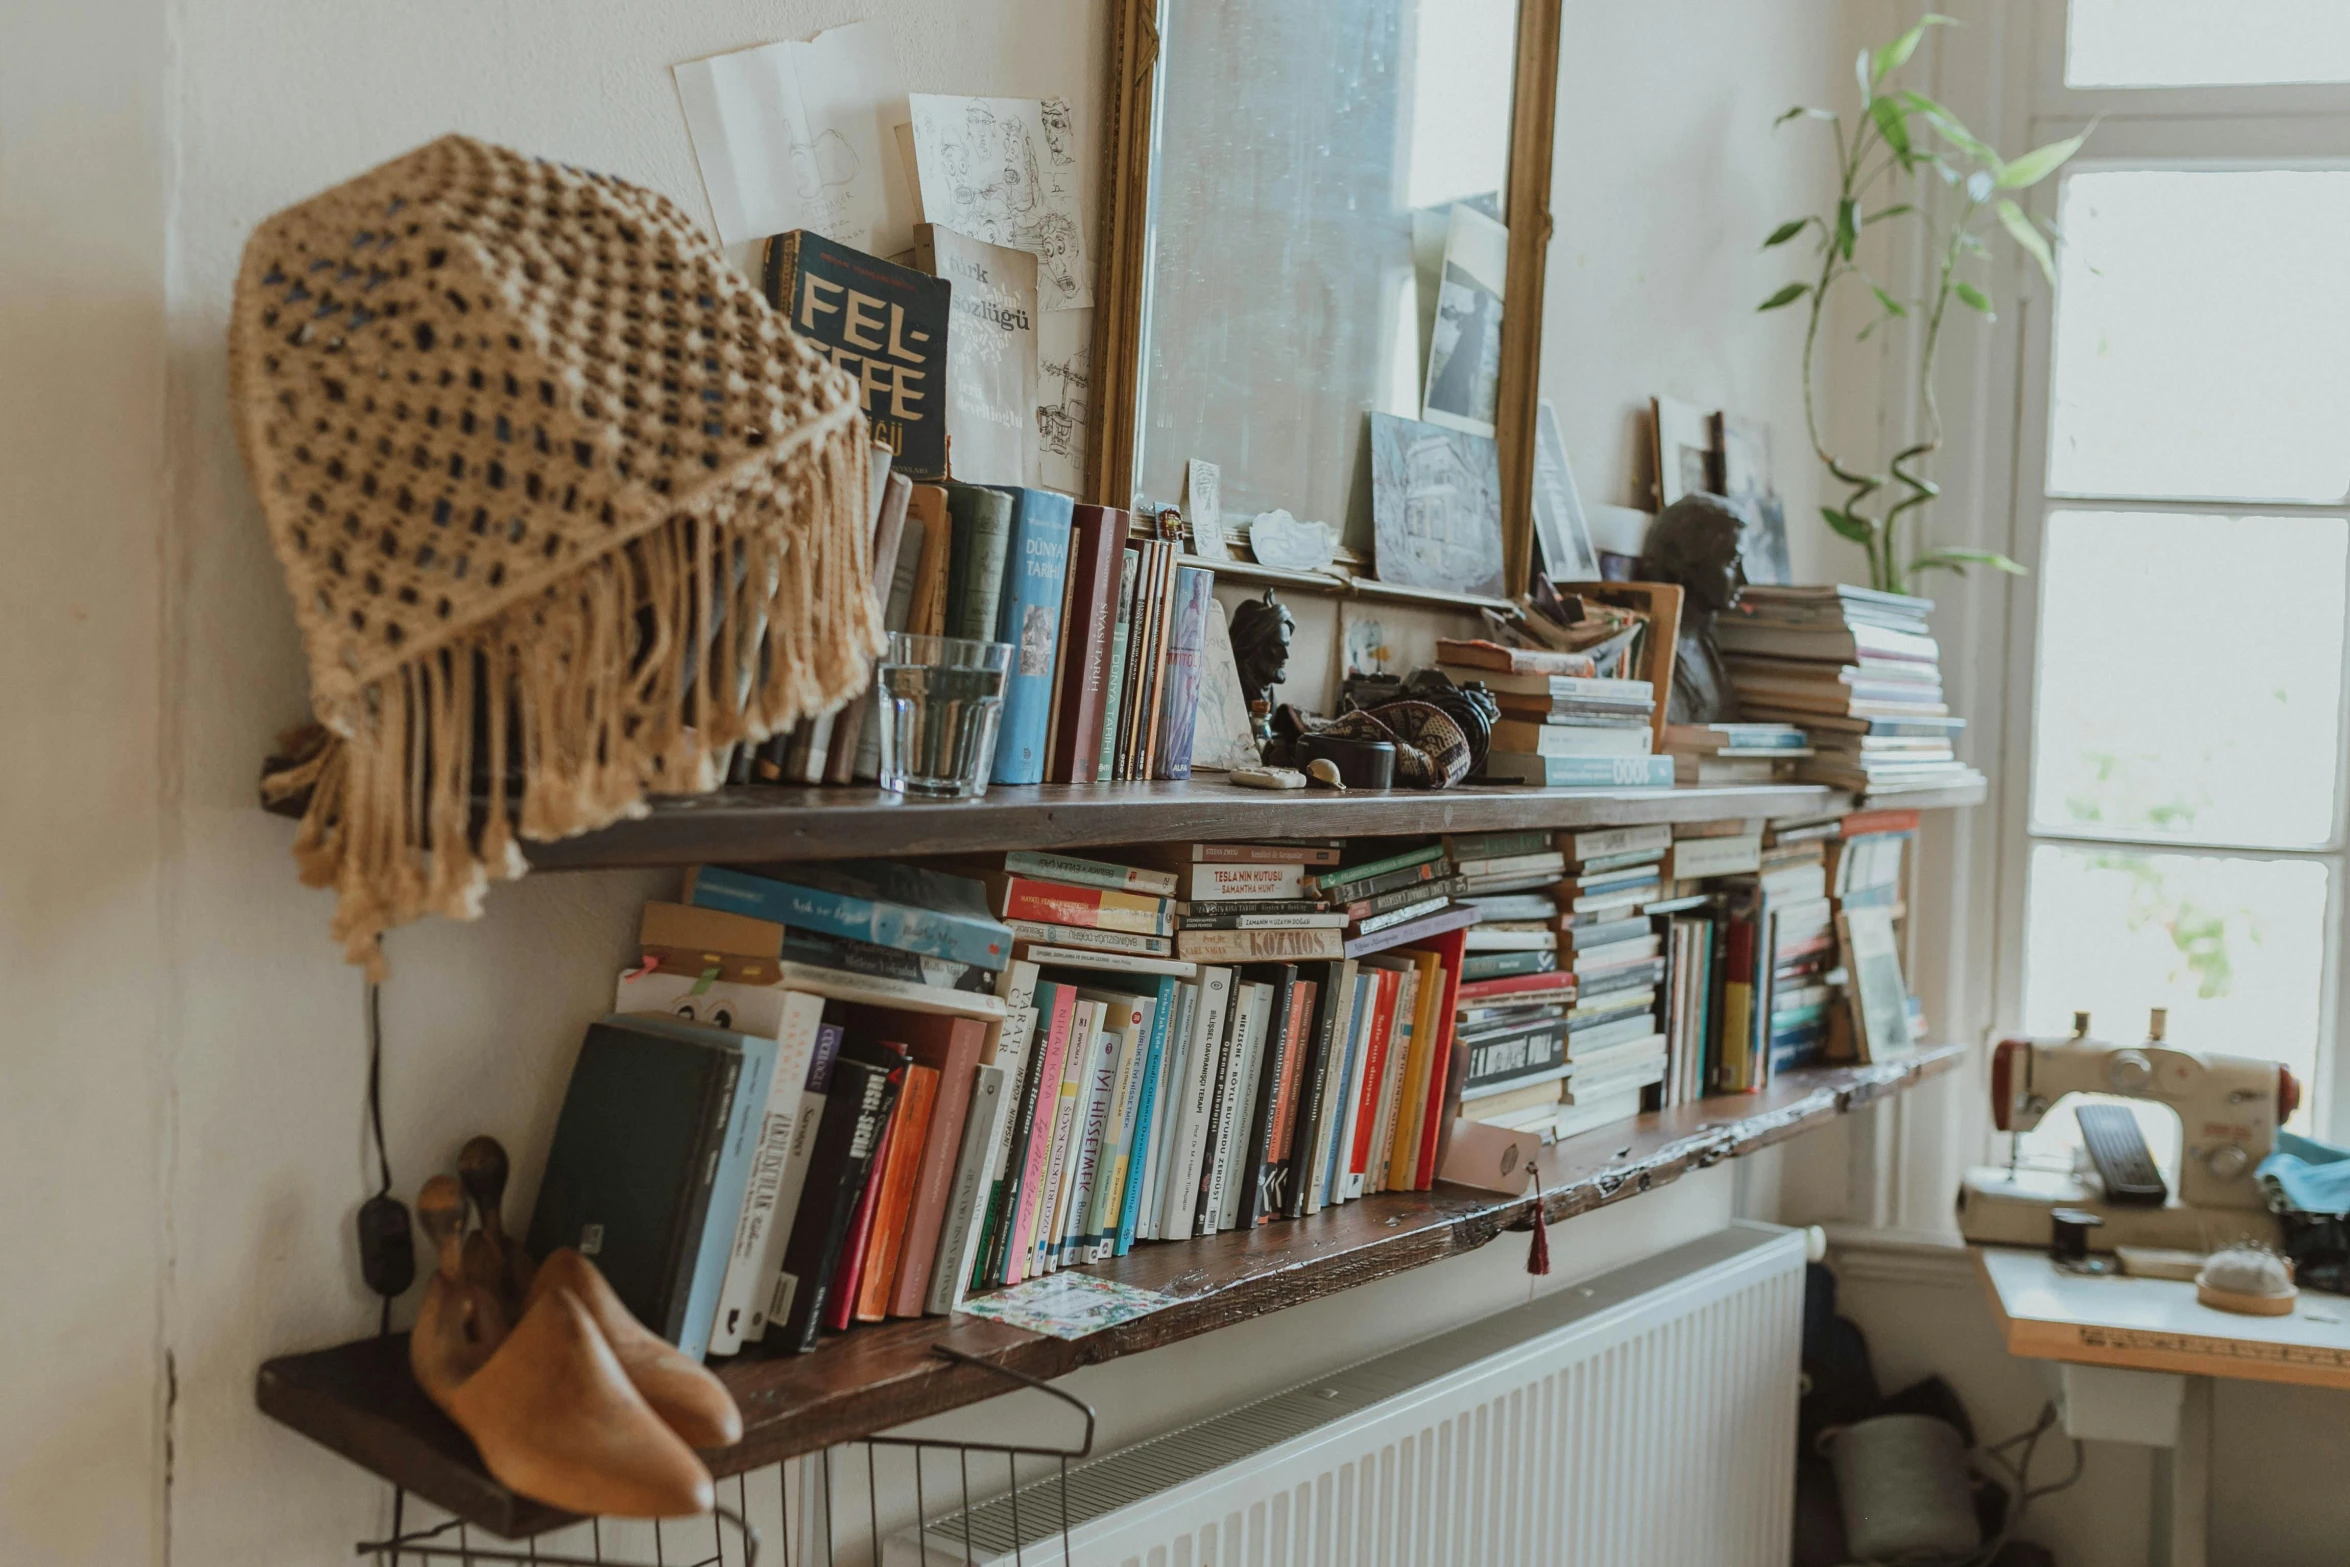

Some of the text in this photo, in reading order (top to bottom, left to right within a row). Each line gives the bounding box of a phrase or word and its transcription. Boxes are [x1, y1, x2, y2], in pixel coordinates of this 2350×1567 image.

[801, 272, 930, 364] FEL-
[953, 296, 1030, 332] sözlüğü
[1026, 539, 1064, 558] DÜNYA
[1026, 560, 1060, 580] TARİHİ
[1090, 602, 1110, 692] SİYASİ TARİH
[1172, 764, 1187, 772] ALFA
[1086, 865, 1114, 878] Beauvoir
[1214, 870, 1282, 882] TESLA'NIN KUTUSU
[1222, 884, 1274, 894] SAMANTHA HUNT
[1020, 894, 1040, 904] HAYATI
[1015, 924, 1044, 937] Beauvoir
[1250, 932, 1325, 956] KOZMOS
[998, 987, 1020, 1053] CILAR
[1008, 990, 1032, 1055] YARATI
[1302, 998, 1311, 1026] Annem
[1325, 1018, 1332, 1028] M
[1050, 1008, 1068, 1056] NİHAN
[1133, 1028, 1146, 1067] BİRLİKTE
[1370, 1014, 1385, 1063] Sofie'nin
[1094, 1067, 1114, 1093] İYİ
[1148, 1054, 1159, 1084] Kendin
[1195, 1009, 1217, 1113] BİLİŞSEL DAVRANIŞÇI TERAPİ
[1262, 980, 1294, 1150] Yalom Günübirlik Hayatlar
[1023, 1038, 1047, 1134] Bilincin Haritası
[1043, 1063, 1057, 1100] KAYA
[1209, 1040, 1231, 1132] Öğrenme Psikolojisi
[1226, 1071, 1239, 1102] BÖYLE
[1309, 1068, 1324, 1121] Patti Smith
[1002, 1066, 1024, 1147] İNSANIN KÖKENİ
[1123, 1080, 1138, 1129] HİSSETMEK
[1075, 1099, 1107, 1193] HİSSETMEK
[1218, 1106, 1233, 1154] BUYURDU
[1038, 1105, 1072, 1234] ÖZGÜRLÜKTEN KAÇIŞ
[1210, 1157, 1226, 1201] ZERDÜŞT
[1072, 1200, 1086, 1229] Burns
